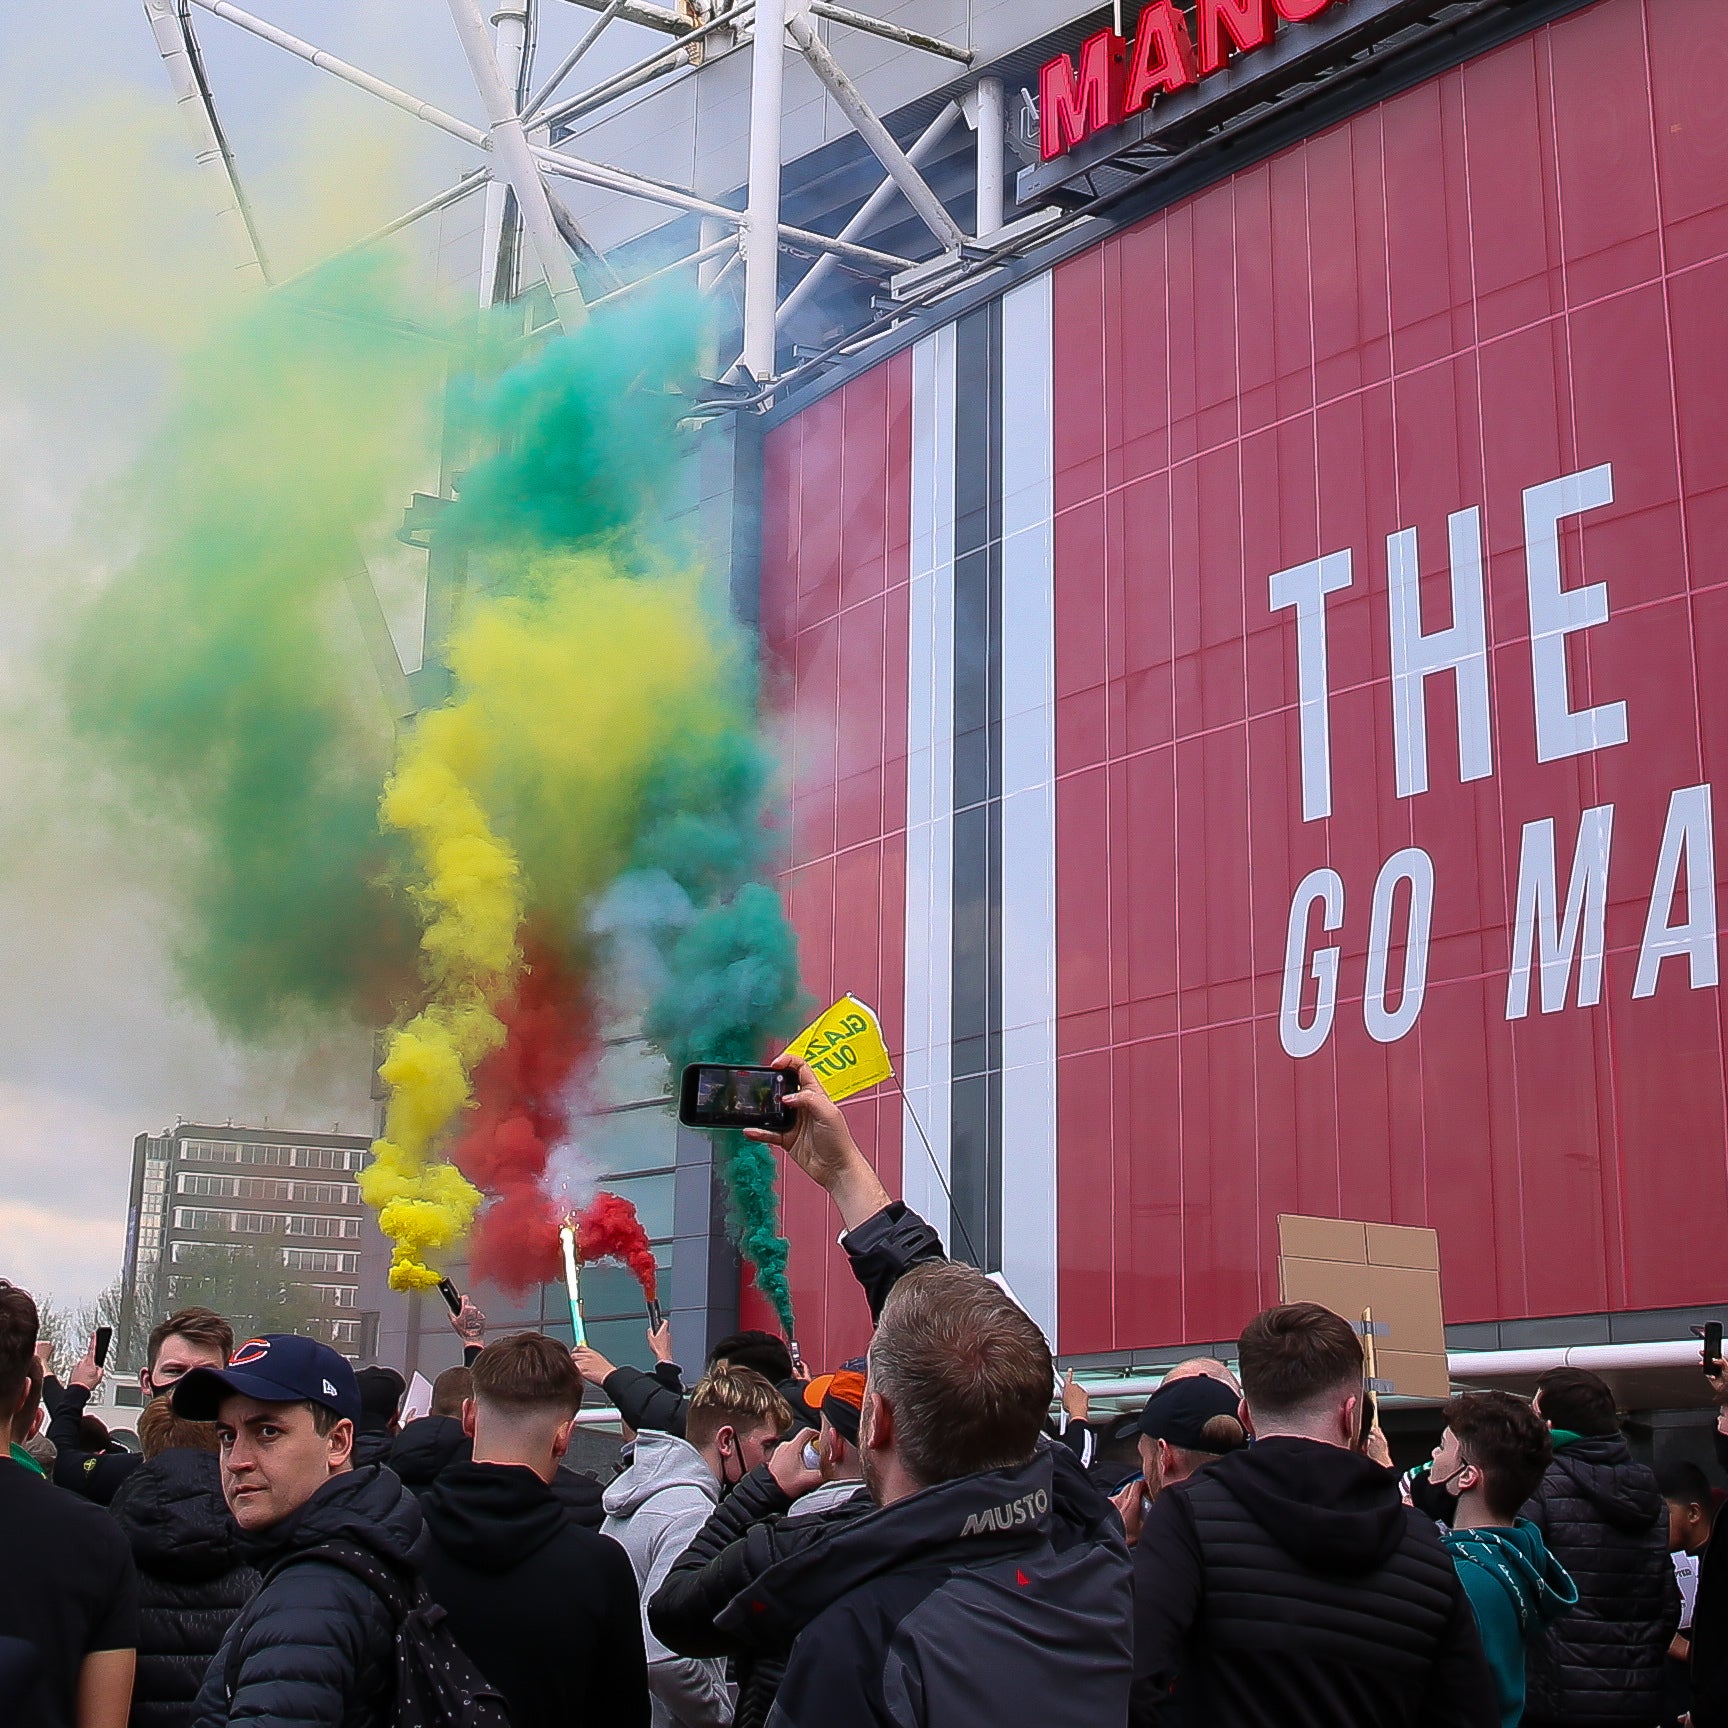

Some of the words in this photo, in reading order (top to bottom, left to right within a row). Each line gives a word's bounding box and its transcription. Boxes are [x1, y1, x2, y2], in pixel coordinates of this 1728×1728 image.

[1269, 462, 1629, 823] THE
[1279, 847, 1434, 1058] GO
[959, 1488, 1048, 1537] MUSTO
